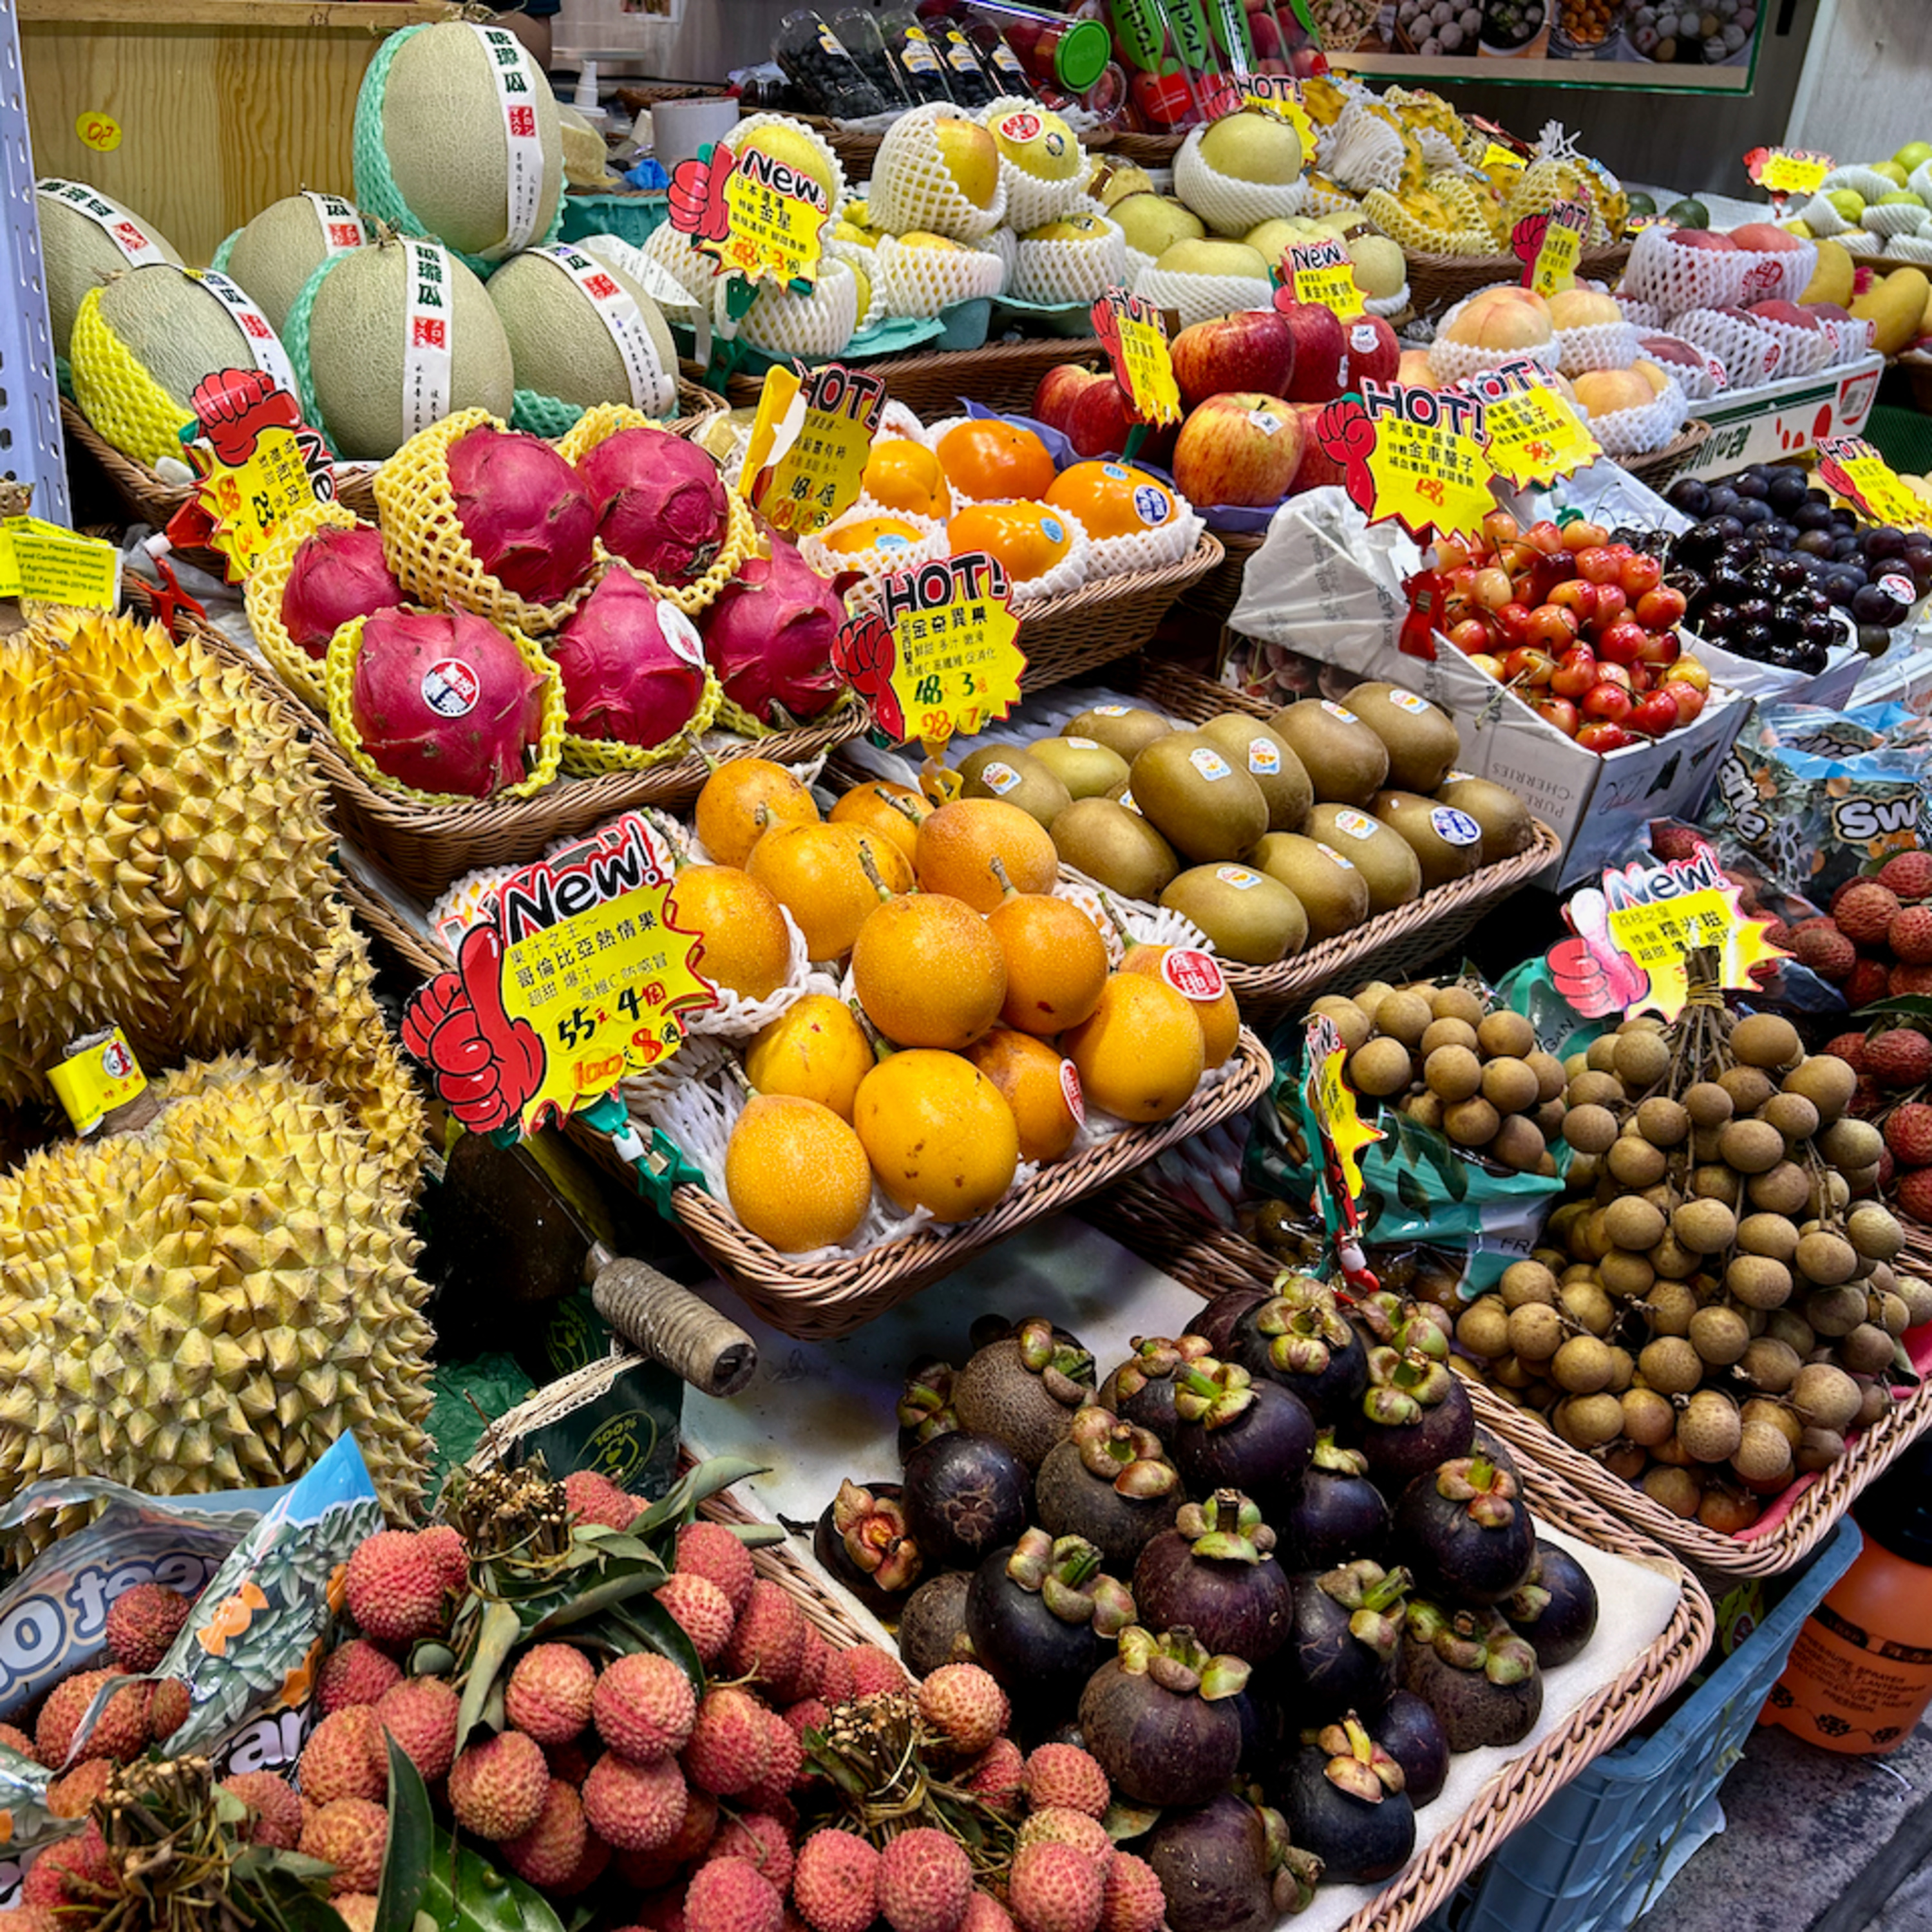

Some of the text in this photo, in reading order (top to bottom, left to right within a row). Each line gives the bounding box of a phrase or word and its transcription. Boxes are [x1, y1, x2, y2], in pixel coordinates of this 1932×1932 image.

[1237, 76, 1303, 103] HOT!
[1365, 381, 1487, 444] HOT!
[297, 434, 336, 504] Ne
[885, 554, 1007, 626] HOT!
[1524, 794, 1566, 819] PURE
[509, 821, 657, 945] New!
[1613, 846, 1725, 914] New!
[594, 1416, 638, 1448] 100%
[1856, 1665, 1905, 1684] SPRAYER
